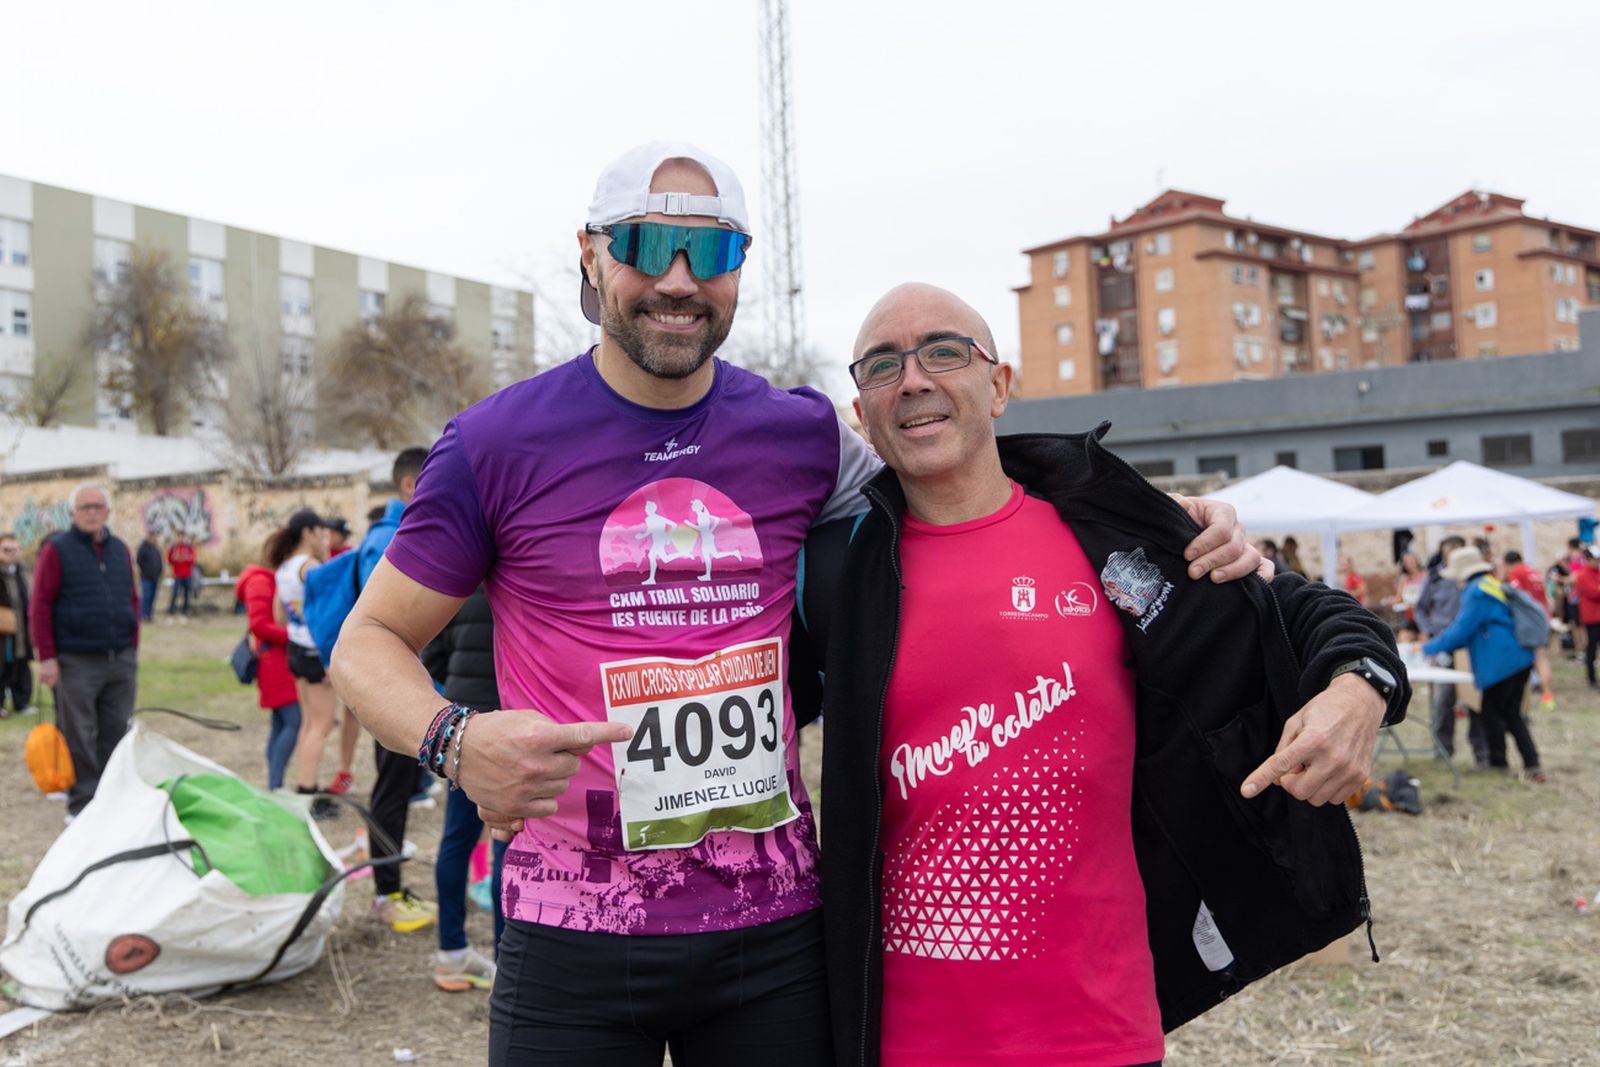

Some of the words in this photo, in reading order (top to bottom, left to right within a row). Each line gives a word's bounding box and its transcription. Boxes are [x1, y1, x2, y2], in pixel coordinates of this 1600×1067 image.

[644, 445, 701, 462] TEAMERGY
[648, 588, 689, 605] TRAIL
[692, 583, 760, 602] SOLIDARIO
[612, 611, 635, 627] IES
[638, 610, 687, 626] FUENTE
[690, 609, 707, 625] DE
[712, 608, 729, 624] LA
[610, 670, 641, 701] XXVIII
[642, 667, 678, 694] CROSS
[676, 662, 724, 691] POPULAR
[721, 653, 755, 684] CIUDAD
[959, 739, 990, 767] tu
[992, 661, 1077, 747] coleta!
[626, 688, 778, 772] 4093
[704, 766, 737, 779] DAVID
[654, 786, 731, 812] JIMENEZ
[734, 775, 778, 798] LUQUE
